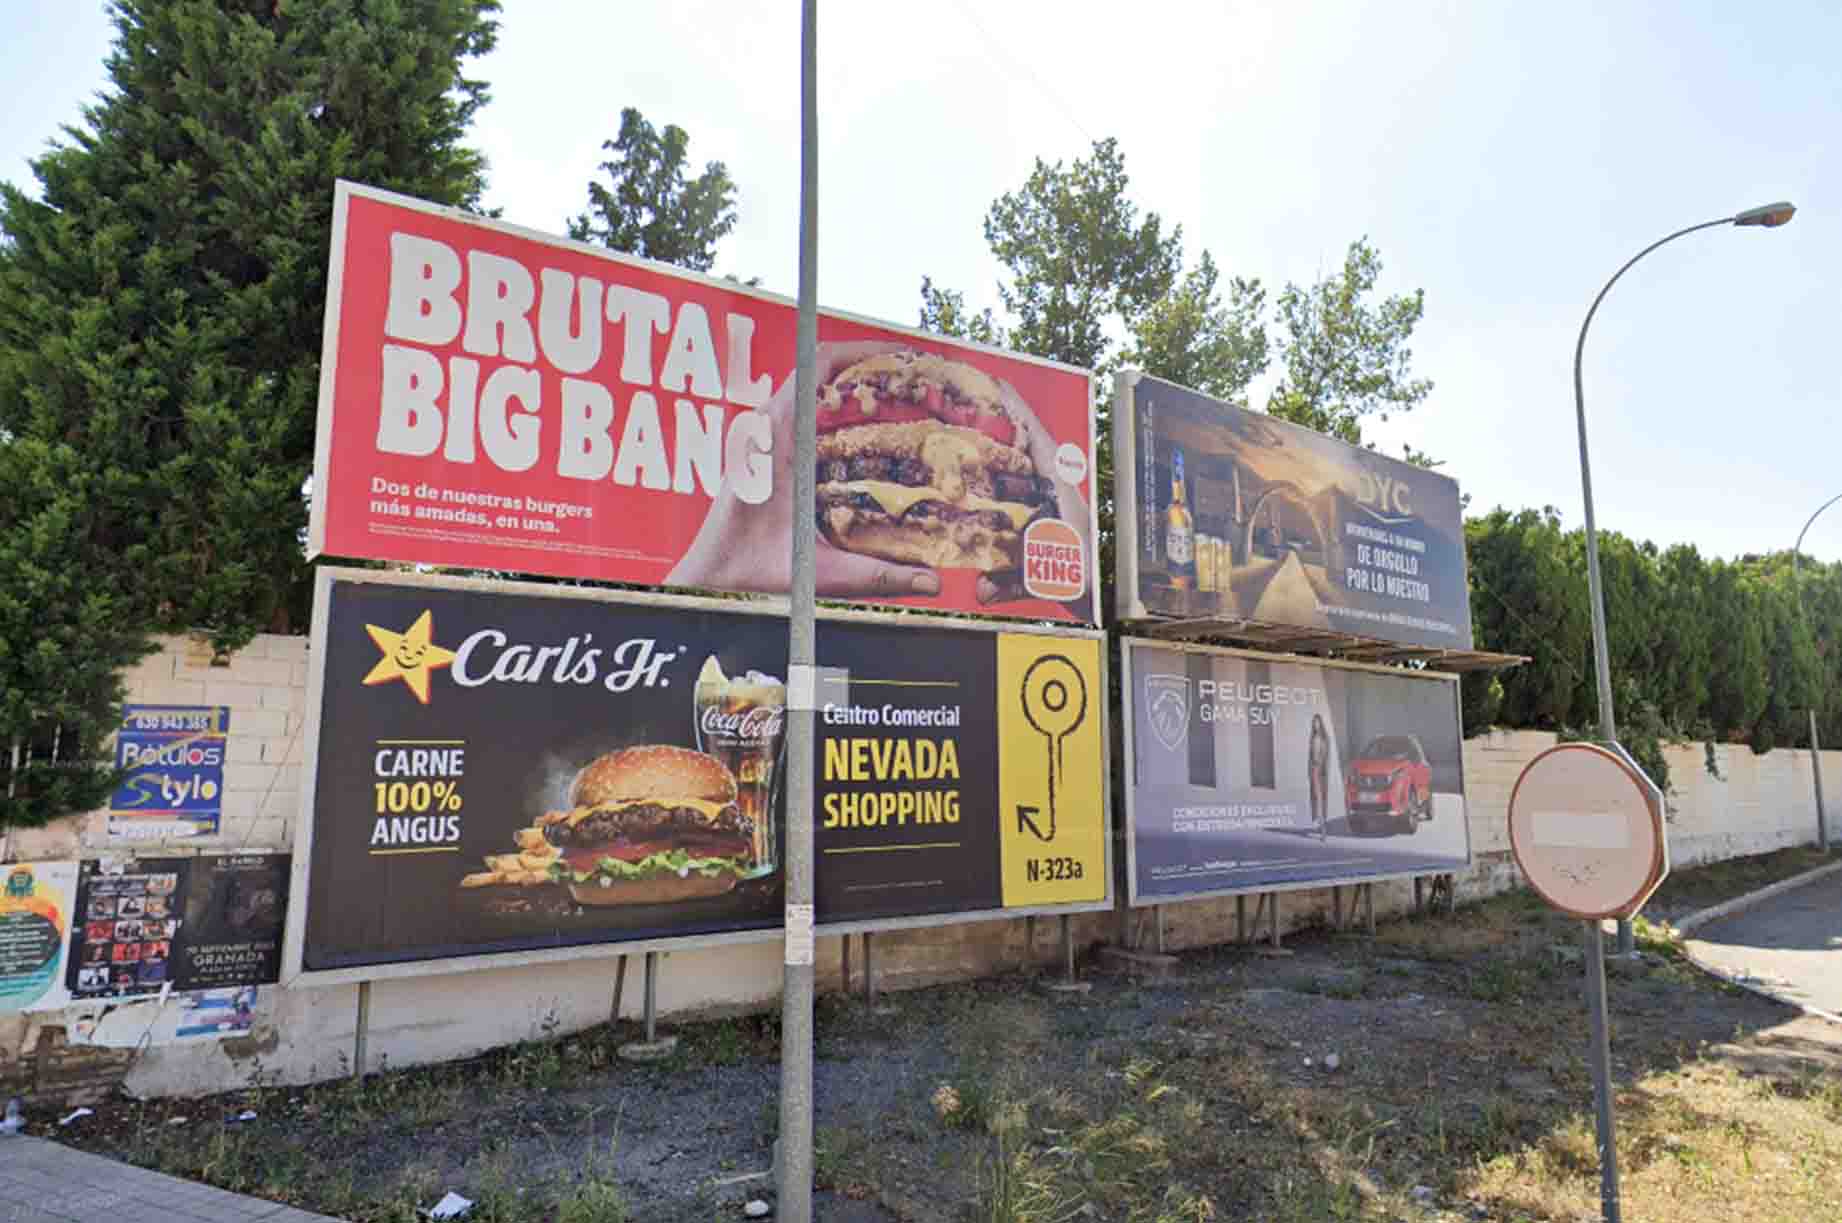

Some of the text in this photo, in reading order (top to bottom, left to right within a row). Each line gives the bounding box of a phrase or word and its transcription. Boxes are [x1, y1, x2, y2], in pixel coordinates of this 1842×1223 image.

[384, 231, 774, 408] BRUTAL
[376, 343, 774, 504] BIG BANG
[371, 477, 593, 519] Dos de nuestras burgers
[1358, 471, 1412, 514] DYC
[370, 498, 560, 534] más amadas, en una.
[1026, 542, 1081, 562] BURGER
[1357, 544, 1372, 566] DE
[1026, 558, 1082, 584] KING
[1345, 567, 1369, 592] POR
[1371, 571, 1385, 593] LO
[450, 628, 677, 693] Carl's Jr.
[1199, 679, 1322, 705] PEUGEOT
[822, 702, 961, 727] Centro Comercial
[374, 748, 464, 778] CARNE
[823, 736, 961, 782] NEVADA
[374, 780, 462, 814] 100%
[823, 790, 961, 829] SHOPPING
[370, 815, 461, 846] ANGUS
[1026, 856, 1084, 882] N-323a
